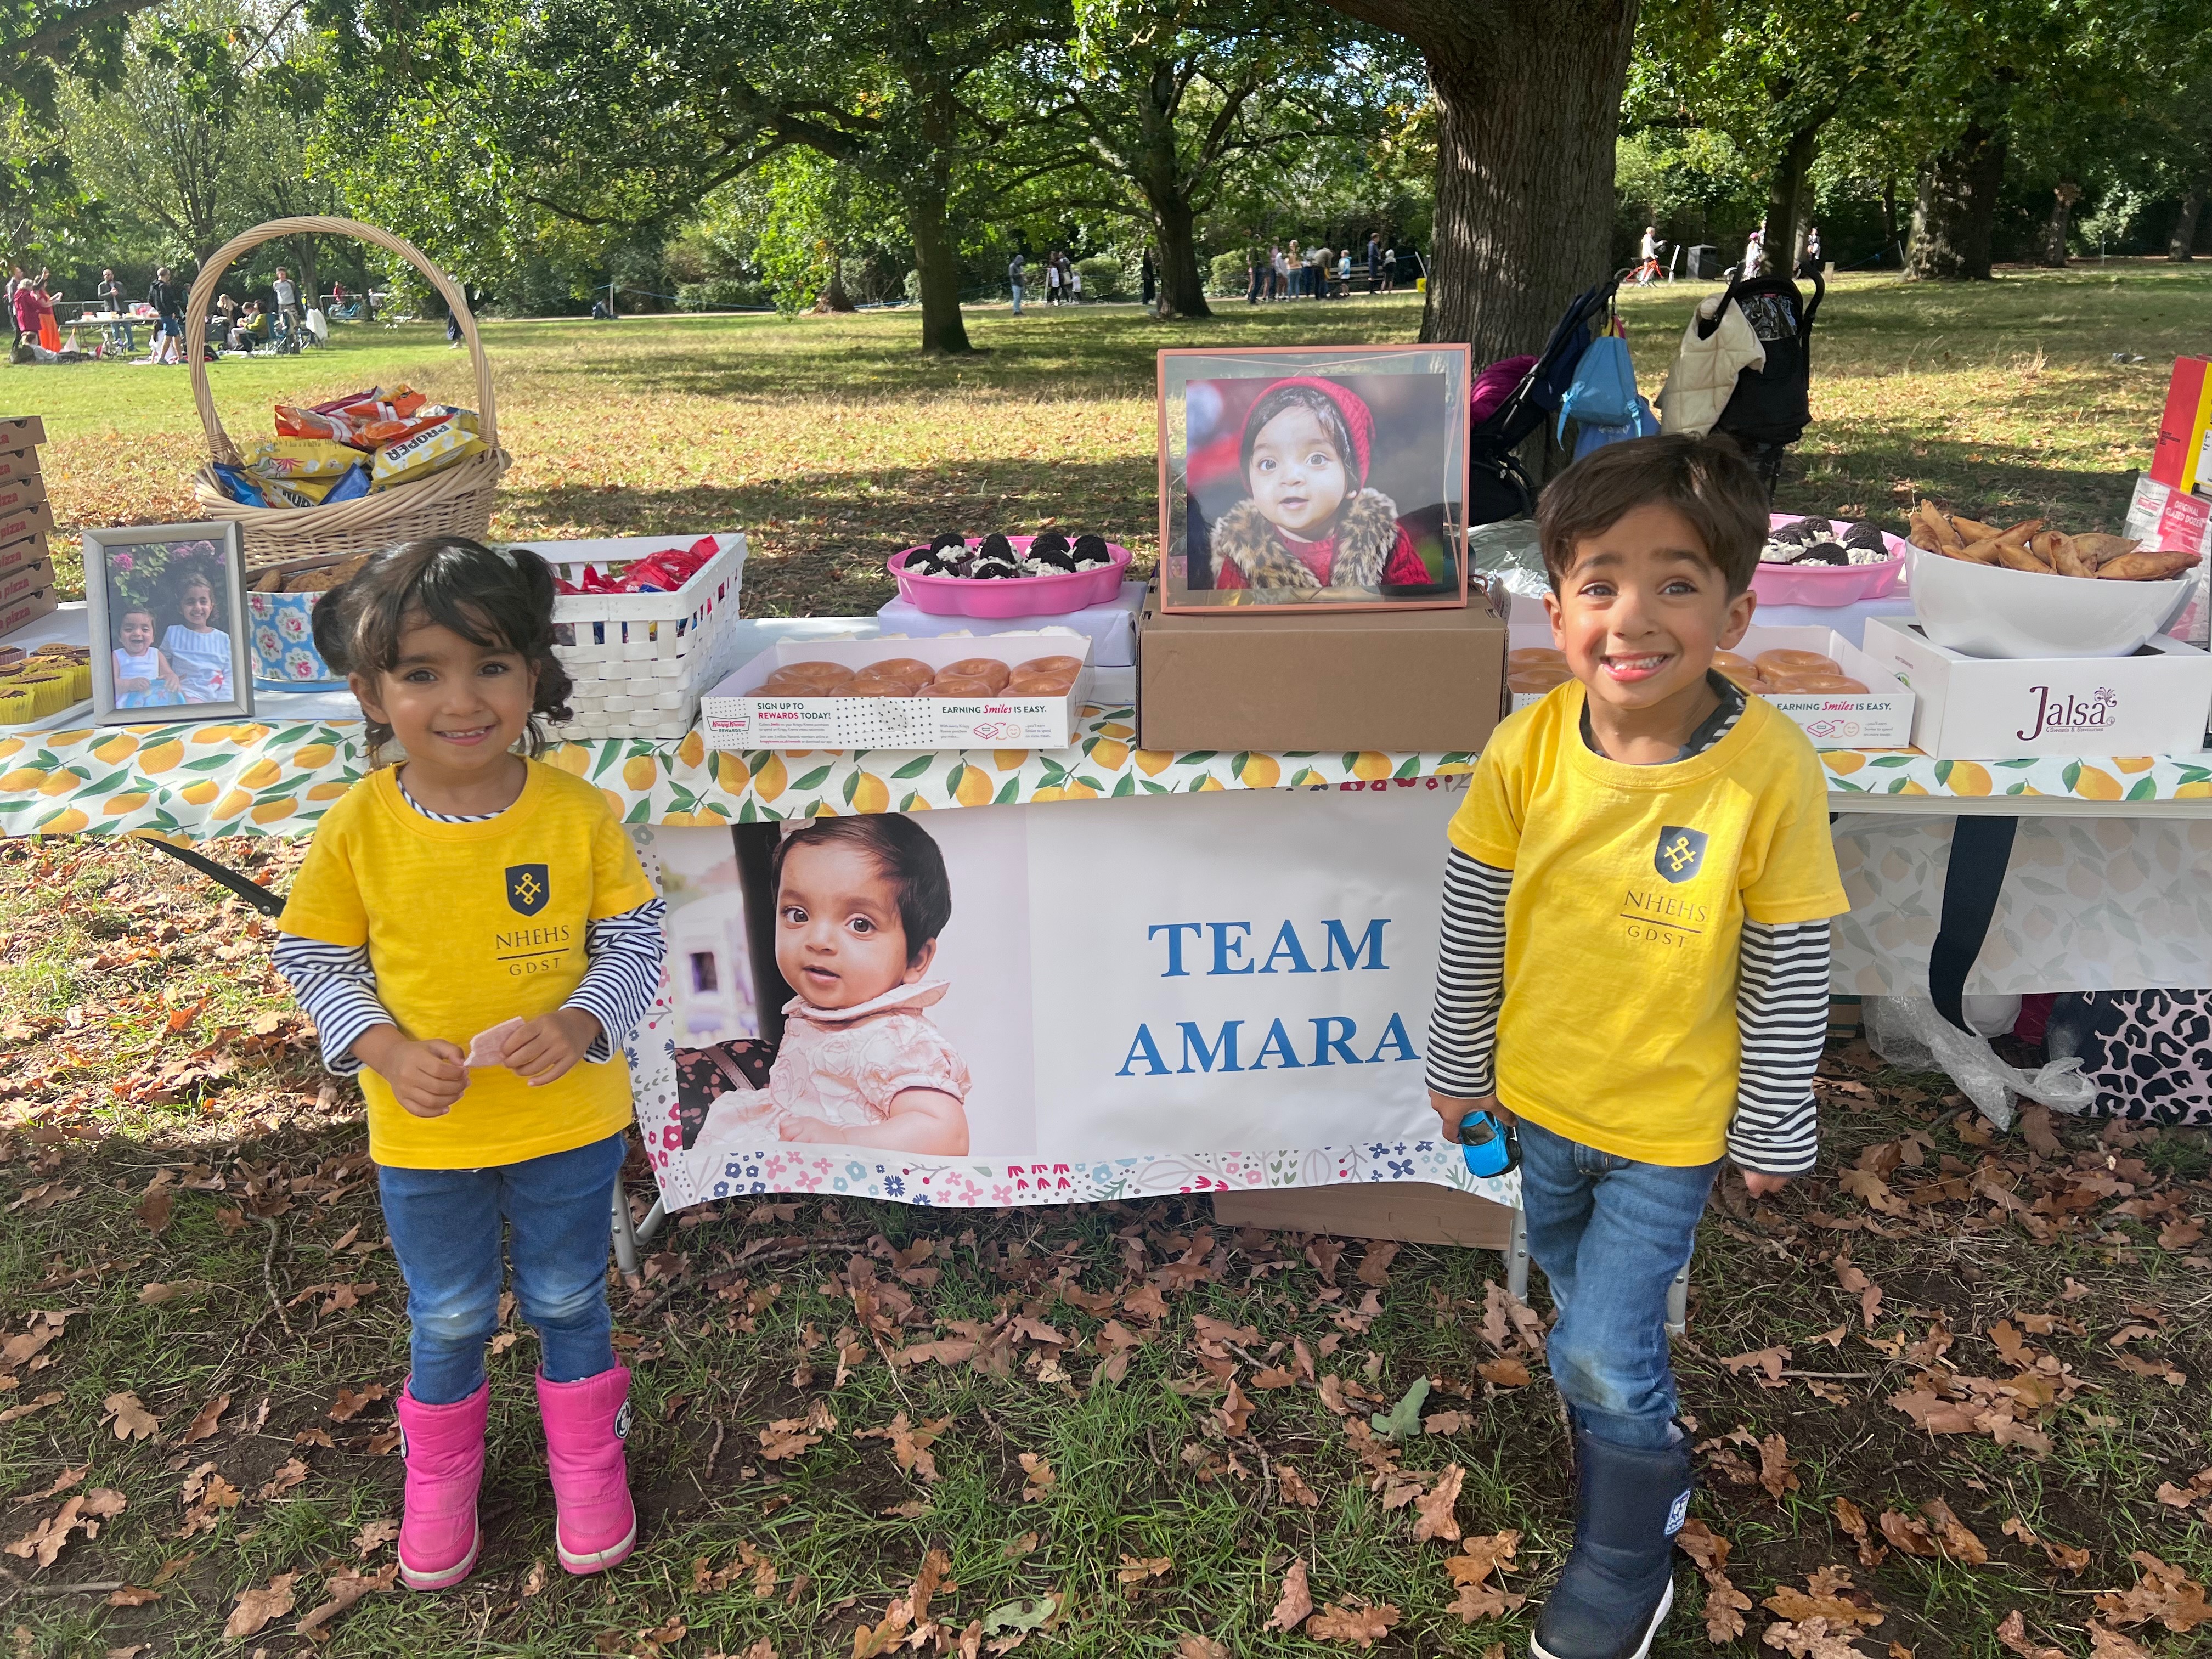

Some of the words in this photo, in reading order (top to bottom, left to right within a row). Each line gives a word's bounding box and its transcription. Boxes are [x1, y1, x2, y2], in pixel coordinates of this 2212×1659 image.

[385, 425, 449, 461] PROPER
[2165, 507, 2185, 521] GLAZED
[2185, 515, 2204, 528] DOZEN
[0, 552, 21, 568] izza
[983, 704, 1012, 713] Smiles
[1821, 701, 1854, 711] Smiles
[2017, 686, 2106, 741] Jalsa
[1624, 890, 1707, 922] NHEHS
[496, 924, 570, 950] NHEHS
[1148, 918, 1392, 978] TEAM
[1628, 925, 1688, 948] GDST
[509, 957, 561, 976] GDST
[1115, 1012, 1422, 1076] AMARA
